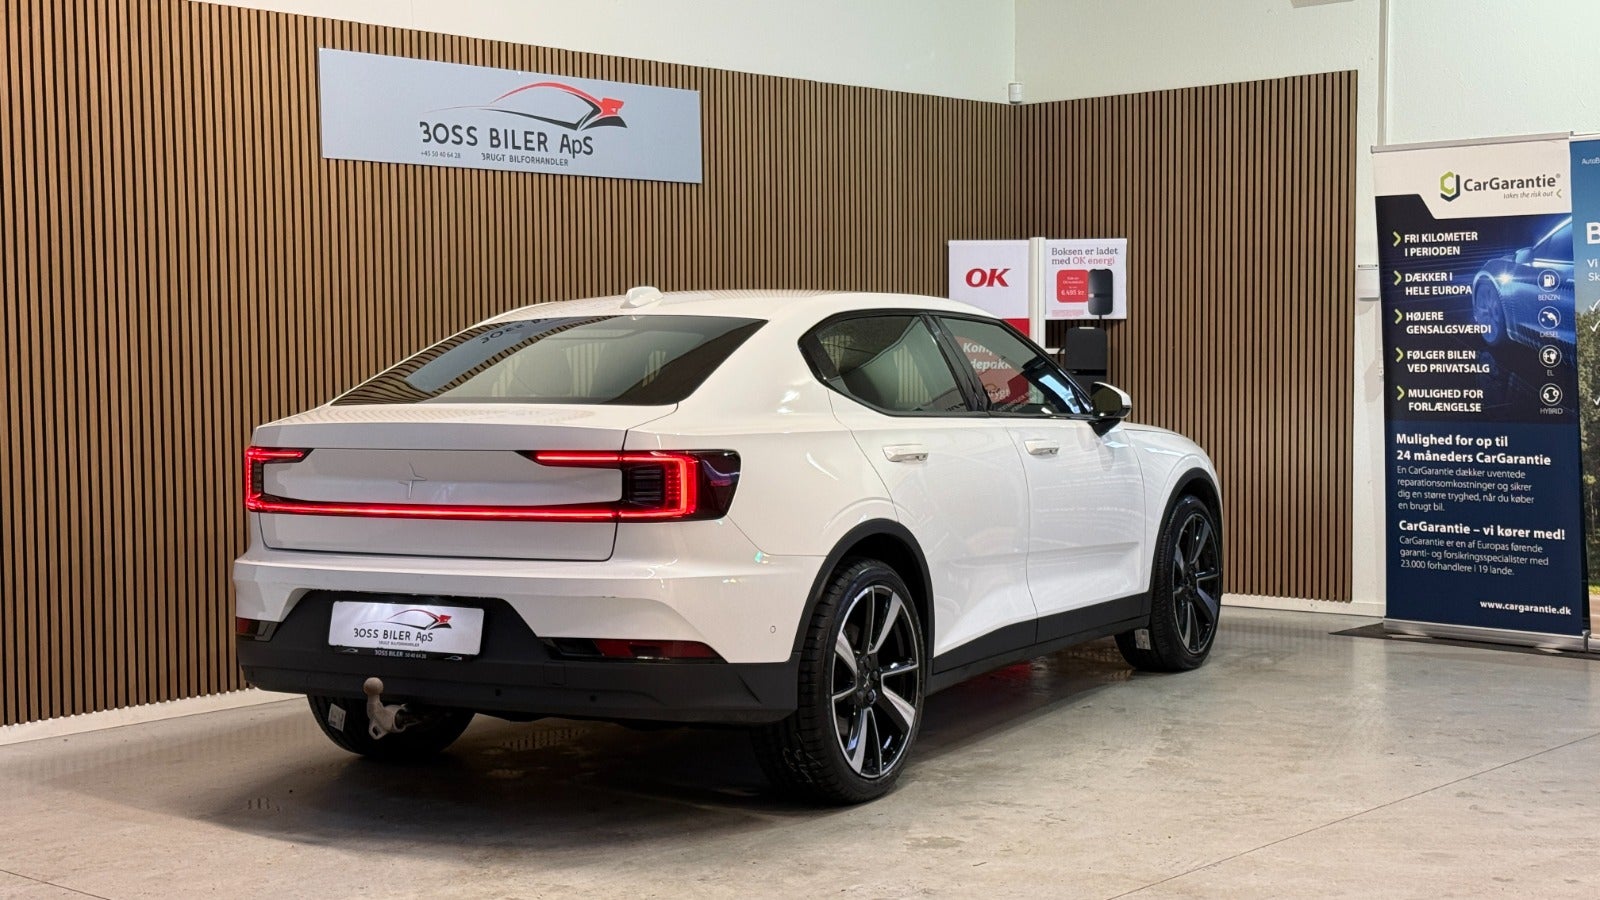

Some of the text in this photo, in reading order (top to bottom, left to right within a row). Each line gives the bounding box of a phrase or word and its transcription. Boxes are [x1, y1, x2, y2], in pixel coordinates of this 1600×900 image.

[489, 128, 548, 152] BILER
[559, 133, 593, 158] ApS
[509, 155, 569, 167] BILFORHANDLER
[1520, 190, 1529, 198] the
[1404, 232, 1478, 243] FRI KILOMETER
[1405, 246, 1460, 256] I PERIODEN
[1088, 257, 1115, 266] energi
[1587, 258, 1598, 268] Vi
[966, 268, 1011, 288] OK
[1405, 272, 1452, 282] DÆKKER I
[1406, 285, 1472, 295] HELE EUROPA
[1406, 312, 1444, 320] HØJERE
[1406, 325, 1492, 334] GENSALGSVÆRDI
[1407, 350, 1476, 359] FØLGER BILEN
[1407, 364, 1489, 373] VED PRIVATSALG
[1408, 389, 1483, 398] MULIGHED FOR
[1408, 402, 1481, 412] FORLÆNGELSE
[1397, 434, 1508, 448] Mulighed for op til
[1397, 450, 1551, 466] 24 måneders CarGarantie
[1408, 466, 1454, 476] CarGarantie
[1456, 468, 1484, 477] dækker
[1487, 470, 1526, 479] uventede
[1398, 479, 1532, 492] reparationsomkostninger og sikrer
[1398, 489, 1410, 499] dig
[1424, 491, 1446, 499] større
[1448, 492, 1481, 503] tryghed,
[1483, 493, 1495, 502] når
[1498, 494, 1508, 502] du
[1510, 495, 1534, 504] køber
[1410, 502, 1431, 512] brugt
[1433, 502, 1445, 511] bil.
[1399, 520, 1471, 534] CarGarantie
[1483, 525, 1494, 535] vi
[1497, 526, 1530, 538] kører
[1534, 529, 1565, 540] med!
[1399, 535, 1444, 546] CarGarantie
[1456, 540, 1466, 548] en
[1468, 540, 1475, 548] af
[1477, 541, 1509, 552] Europas
[1511, 543, 1543, 552] førende
[1399, 549, 1549, 565] garanti- og forsikringsspecialister med
[1401, 560, 1425, 569] 23.000
[1427, 561, 1472, 573] forhandlere
[1479, 565, 1488, 573] 19
[1490, 565, 1514, 575] lande.
[1480, 600, 1571, 616] www.cargarantie.dk
[383, 630, 410, 640] BILER
[416, 632, 433, 643] ApS
